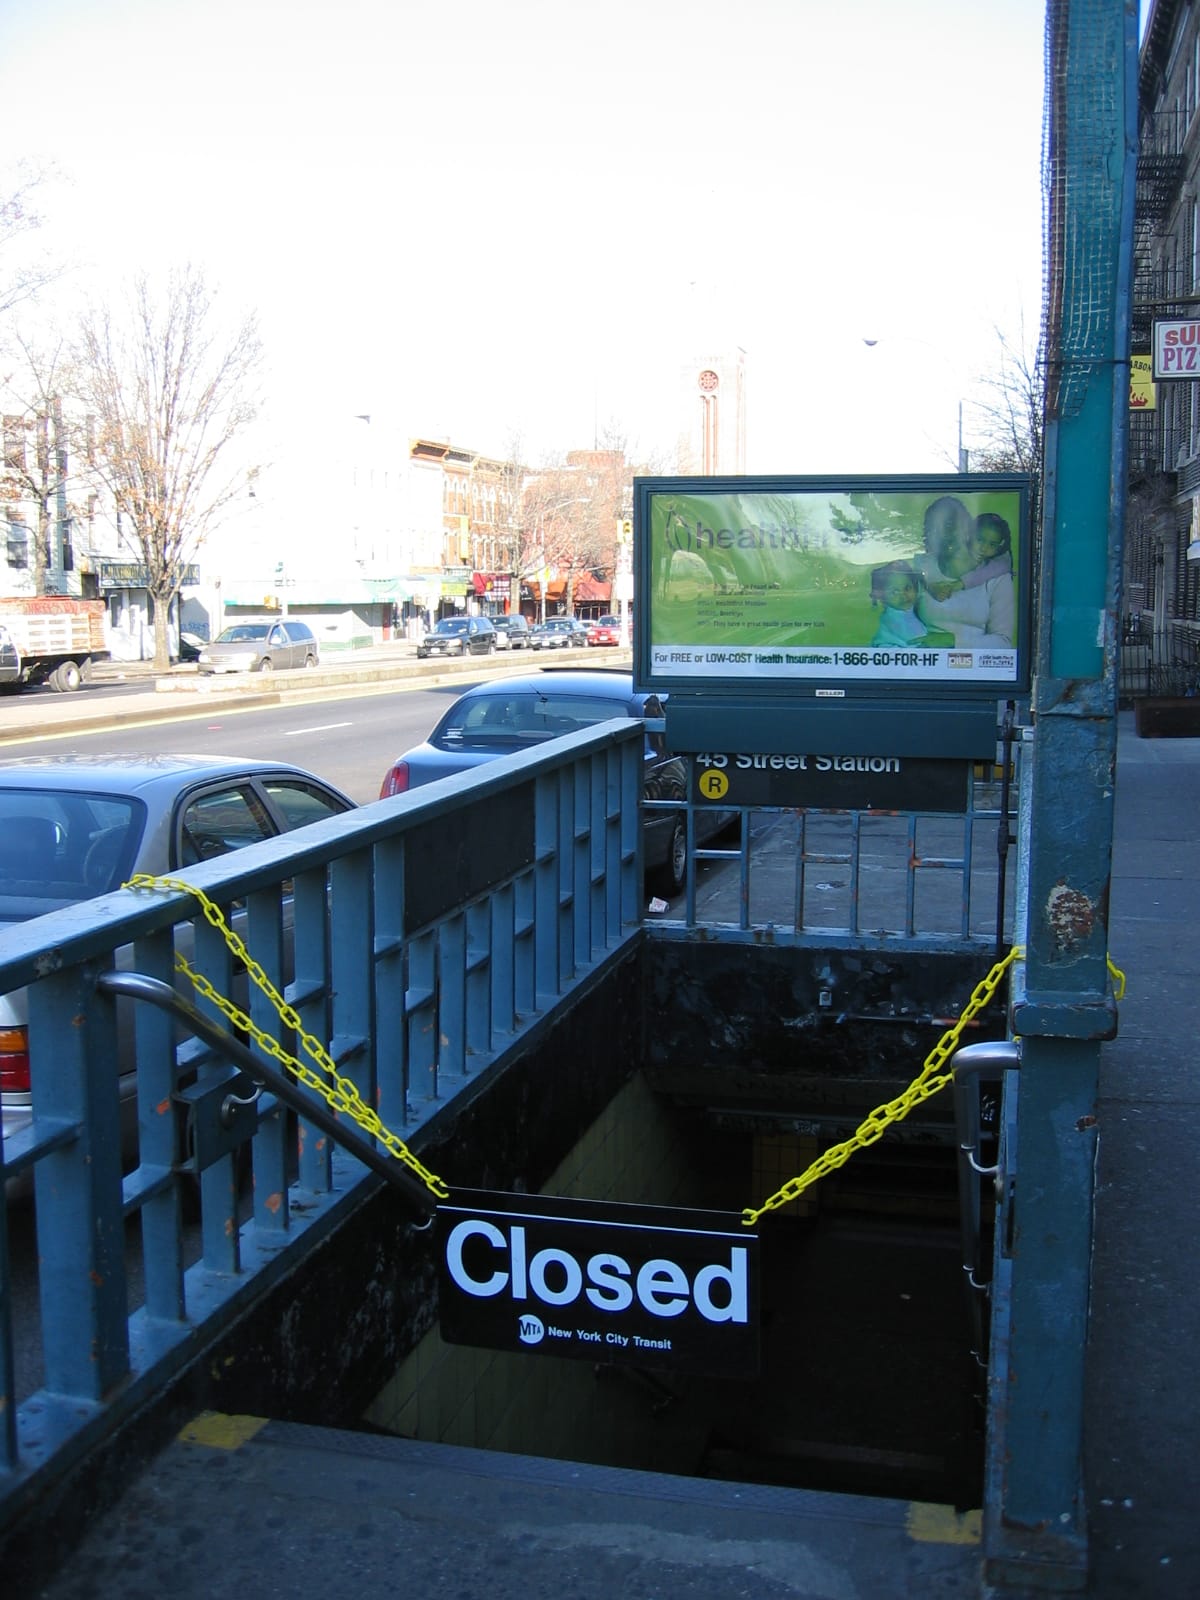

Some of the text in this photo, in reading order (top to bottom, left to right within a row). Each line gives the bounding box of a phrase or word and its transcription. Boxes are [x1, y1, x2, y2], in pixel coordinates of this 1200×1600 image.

[1164, 325, 1200, 346] SU
[1163, 346, 1200, 371] PIZ
[654, 652, 940, 666] For FREE or LOW-COST Health Insurance: 1-866-GO-FOR-HF
[696, 753, 901, 773] 45 Street Station
[708, 776, 722, 794] R
[446, 1219, 748, 1323] Closed
[519, 1317, 672, 1350] MTA New York City Transit
